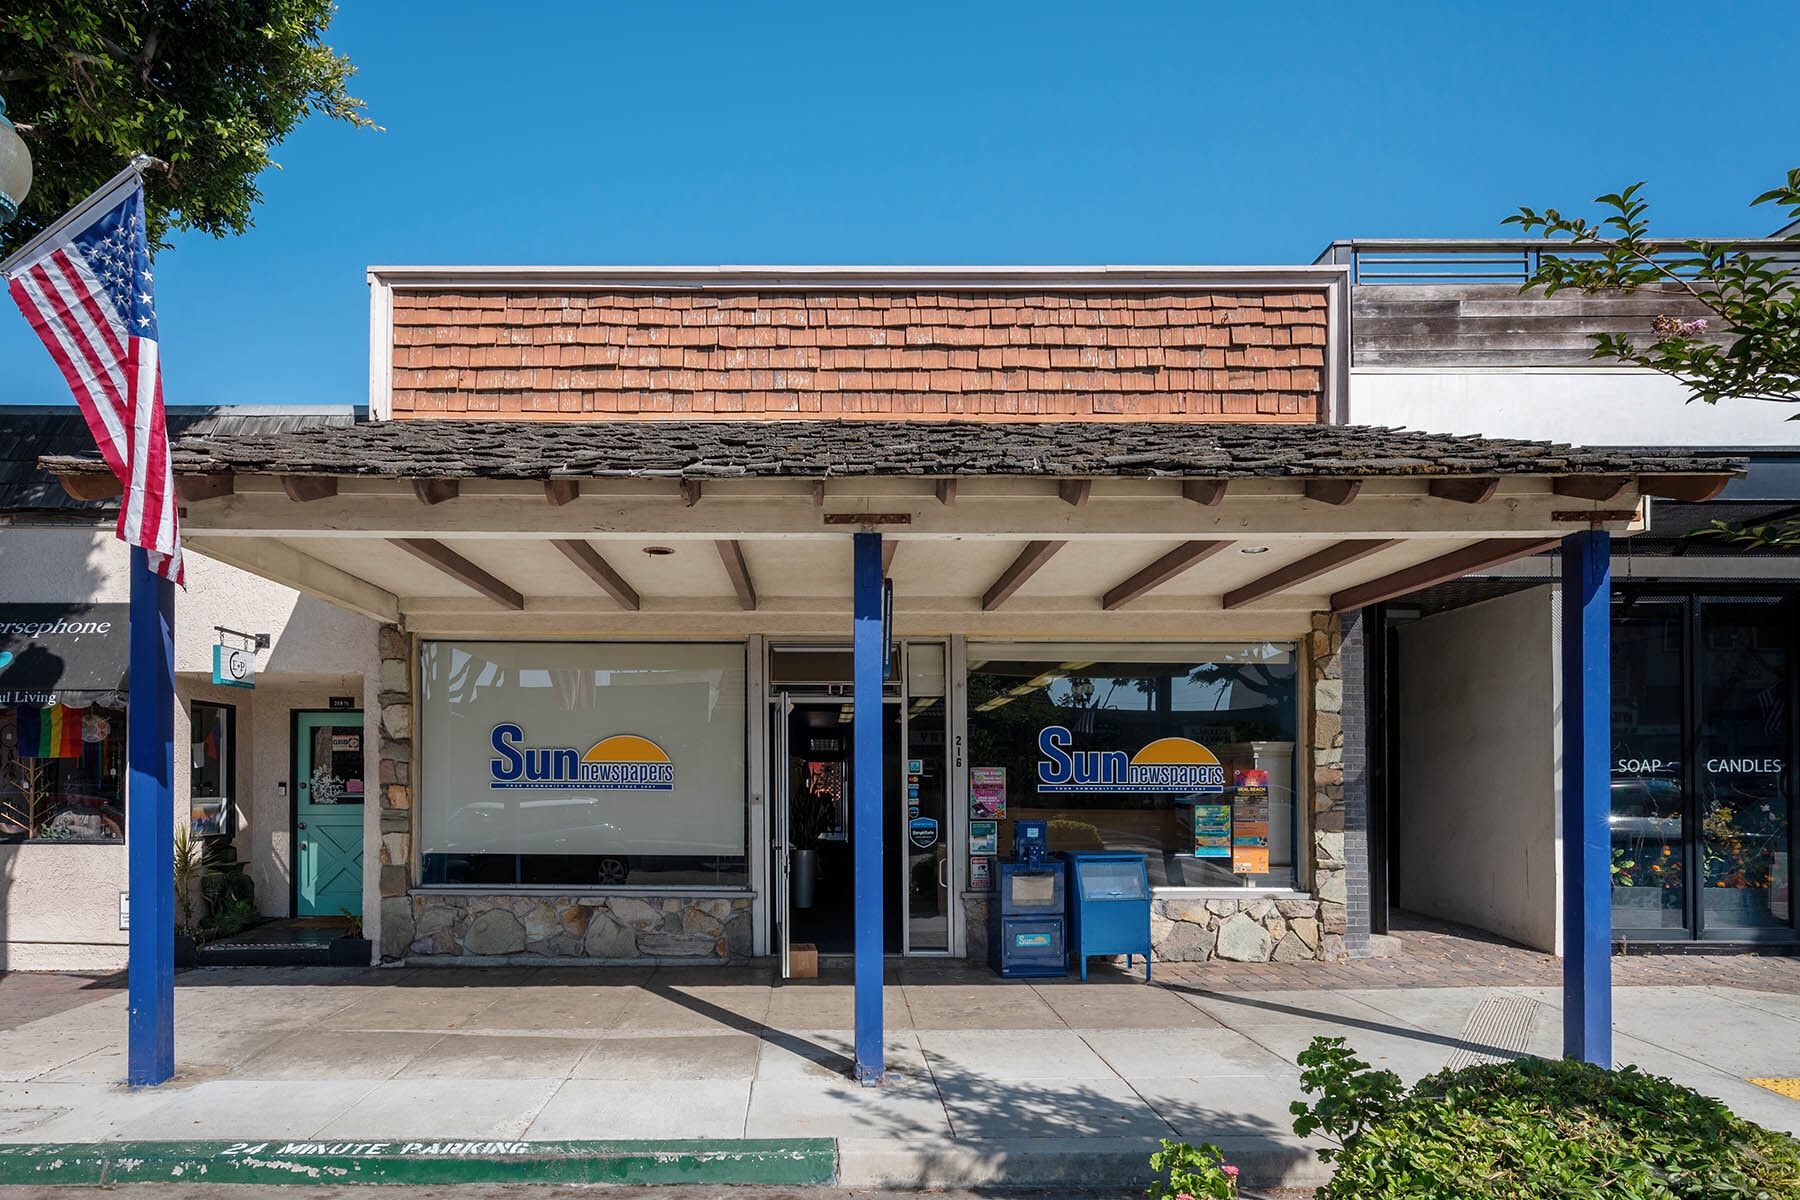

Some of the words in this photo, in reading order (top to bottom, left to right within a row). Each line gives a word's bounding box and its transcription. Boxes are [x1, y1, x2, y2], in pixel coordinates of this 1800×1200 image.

[15, 691, 57, 705] Living
[490, 723, 579, 781] Sun
[580, 763, 674, 783] newspapers
[1038, 726, 1128, 784] Sun
[1129, 766, 1224, 786] newspapers
[1618, 759, 1662, 773] SOAP
[1707, 759, 1782, 773] CANDLES
[221, 1143, 268, 1155] 24
[275, 1143, 391, 1155] MINUTE
[400, 1142, 530, 1155] PARKING
